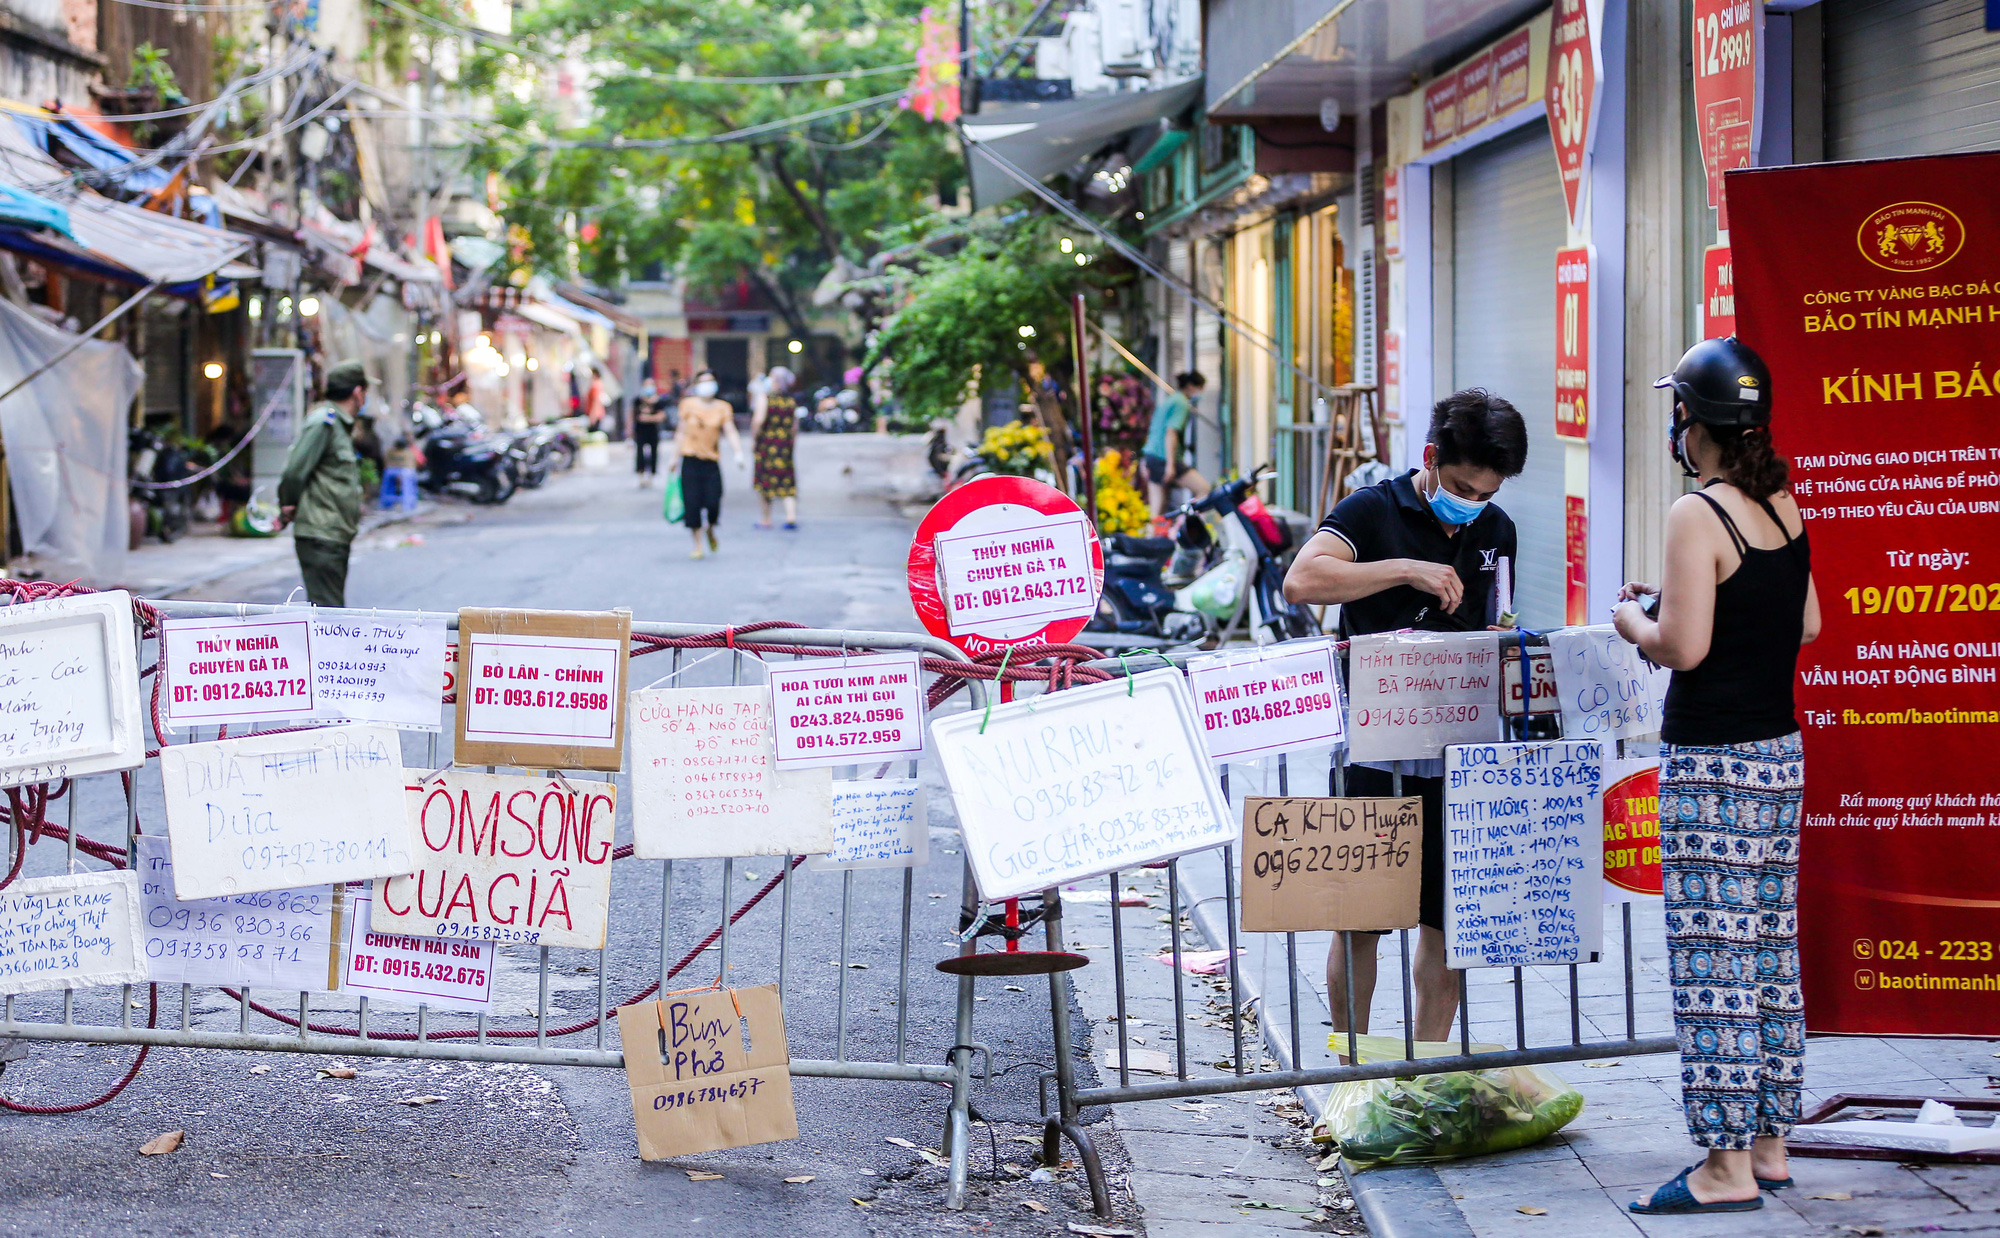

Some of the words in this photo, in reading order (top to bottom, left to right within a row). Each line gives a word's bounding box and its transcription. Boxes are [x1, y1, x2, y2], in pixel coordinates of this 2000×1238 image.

[1697, 12, 1719, 78] 12
[1720, 29, 1751, 72] 999.9
[1874, 212, 1891, 226] BẢO
[1891, 207, 1905, 217] TÍN
[1905, 207, 1931, 217] MẠNH
[1930, 209, 1945, 221] HẢI
[1804, 290, 1852, 305] CÔNG
[1854, 289, 1875, 302] TY
[1878, 286, 1925, 300] VÀNG
[1928, 284, 1963, 299] BẠC
[1966, 279, 1991, 295] ĐÁ
[1804, 308, 1857, 333] BẢO
[1860, 307, 1901, 329] TÍN
[1907, 305, 1983, 329] MẠNH
[1822, 367, 1923, 405] KÍNH
[1794, 455, 1826, 471] TẠM
[1828, 452, 1872, 467] DỪNG
[1875, 452, 1910, 465] GIAO
[1913, 449, 1947, 466] DỊCH
[1949, 445, 1986, 462] TRÊN
[1794, 478, 1813, 497] HỆ
[1815, 476, 1866, 493] THỐNG
[1869, 475, 1900, 492] CỬA
[1902, 474, 1944, 490] HÀNG
[1946, 470, 1966, 489] ĐỂ
[1838, 505, 1875, 519] THEO
[1877, 501, 1903, 517] YÊU
[1905, 499, 1934, 516] CẦU
[1937, 498, 1966, 515] CỦA
[972, 540, 1006, 561] THỦY
[1011, 536, 1055, 555] NGHĨA
[1886, 548, 1914, 567] Từ
[1918, 548, 1970, 571] ngày:
[967, 561, 1023, 583] CHUYÊN
[1026, 558, 1046, 574] GÀ
[1048, 556, 1067, 571] TA
[954, 593, 979, 611] ĐT:
[982, 576, 1087, 607] 0912.643.712
[196, 634, 231, 653] THỦY
[236, 634, 279, 651] NGHĨA
[963, 635, 990, 654] NO
[1359, 642, 1393, 669] MẮM
[1399, 645, 1422, 667] TÉP
[1466, 648, 1496, 668] THỊT
[1856, 640, 1894, 660] BÁN
[1898, 639, 1949, 659] HÀNG
[1953, 642, 2000, 658] ONLI
[189, 657, 245, 675] CHUYÊN
[249, 656, 268, 672] GÀ
[271, 657, 289, 670] TA
[483, 662, 504, 679] BÒ
[508, 663, 539, 680] LÂN
[555, 664, 604, 683] CHỈNH
[1800, 665, 1838, 686] VẪN
[1842, 669, 1891, 688] HOẠT
[1894, 665, 1947, 688] ĐỘNG
[1951, 664, 1997, 683] BÌNH
[174, 685, 198, 703] ĐT:
[202, 678, 306, 701] 0912.643.712
[781, 680, 810, 692] HOA
[813, 677, 844, 690] TƯƠI
[848, 676, 875, 687] KIM
[879, 673, 908, 685] ANH
[1204, 683, 1240, 704] MẮM
[1242, 679, 1267, 697] TÉP
[1271, 675, 1298, 692] KIM
[1301, 670, 1324, 686] CHI
[475, 687, 499, 705] ĐT:
[503, 688, 608, 710] 093.612.9598
[796, 696, 810, 707] AI
[814, 691, 843, 706] CẦN
[847, 689, 868, 703] THÌ
[872, 690, 896, 703] GỌI
[790, 707, 904, 729] 0243.824.0596
[1204, 712, 1229, 731] ĐT:
[1232, 692, 1332, 726] 034.682.9999
[1357, 705, 1479, 727] 0912635890
[1804, 709, 1837, 729] Tại:
[1842, 708, 2000, 725] fb.com/baotinma
[796, 728, 901, 749] 0914.572.959
[1839, 791, 1864, 807] Rất
[1867, 794, 1904, 810] mong
[1906, 793, 1932, 810] quý
[1934, 793, 1976, 808] khách
[1254, 799, 1294, 837] CÁ
[1302, 801, 1356, 836] KHO
[1805, 813, 1836, 827] kính
[1839, 814, 1871, 827] chúc
[1873, 813, 1899, 830] quý
[1901, 813, 1943, 827] khách
[1946, 813, 1985, 830] mạnh
[1604, 847, 1638, 869] SĐT
[436, 922, 540, 946] 0915827038
[365, 933, 420, 951] CHUYÊN
[424, 937, 448, 955] HẢI
[451, 939, 480, 960] SẢN
[1878, 940, 1920, 960] 024
[1939, 940, 1994, 961] 2233
[354, 954, 378, 974] ĐT:
[382, 957, 486, 987] 0915.432.675
[653, 1077, 766, 1112] 0986784657
